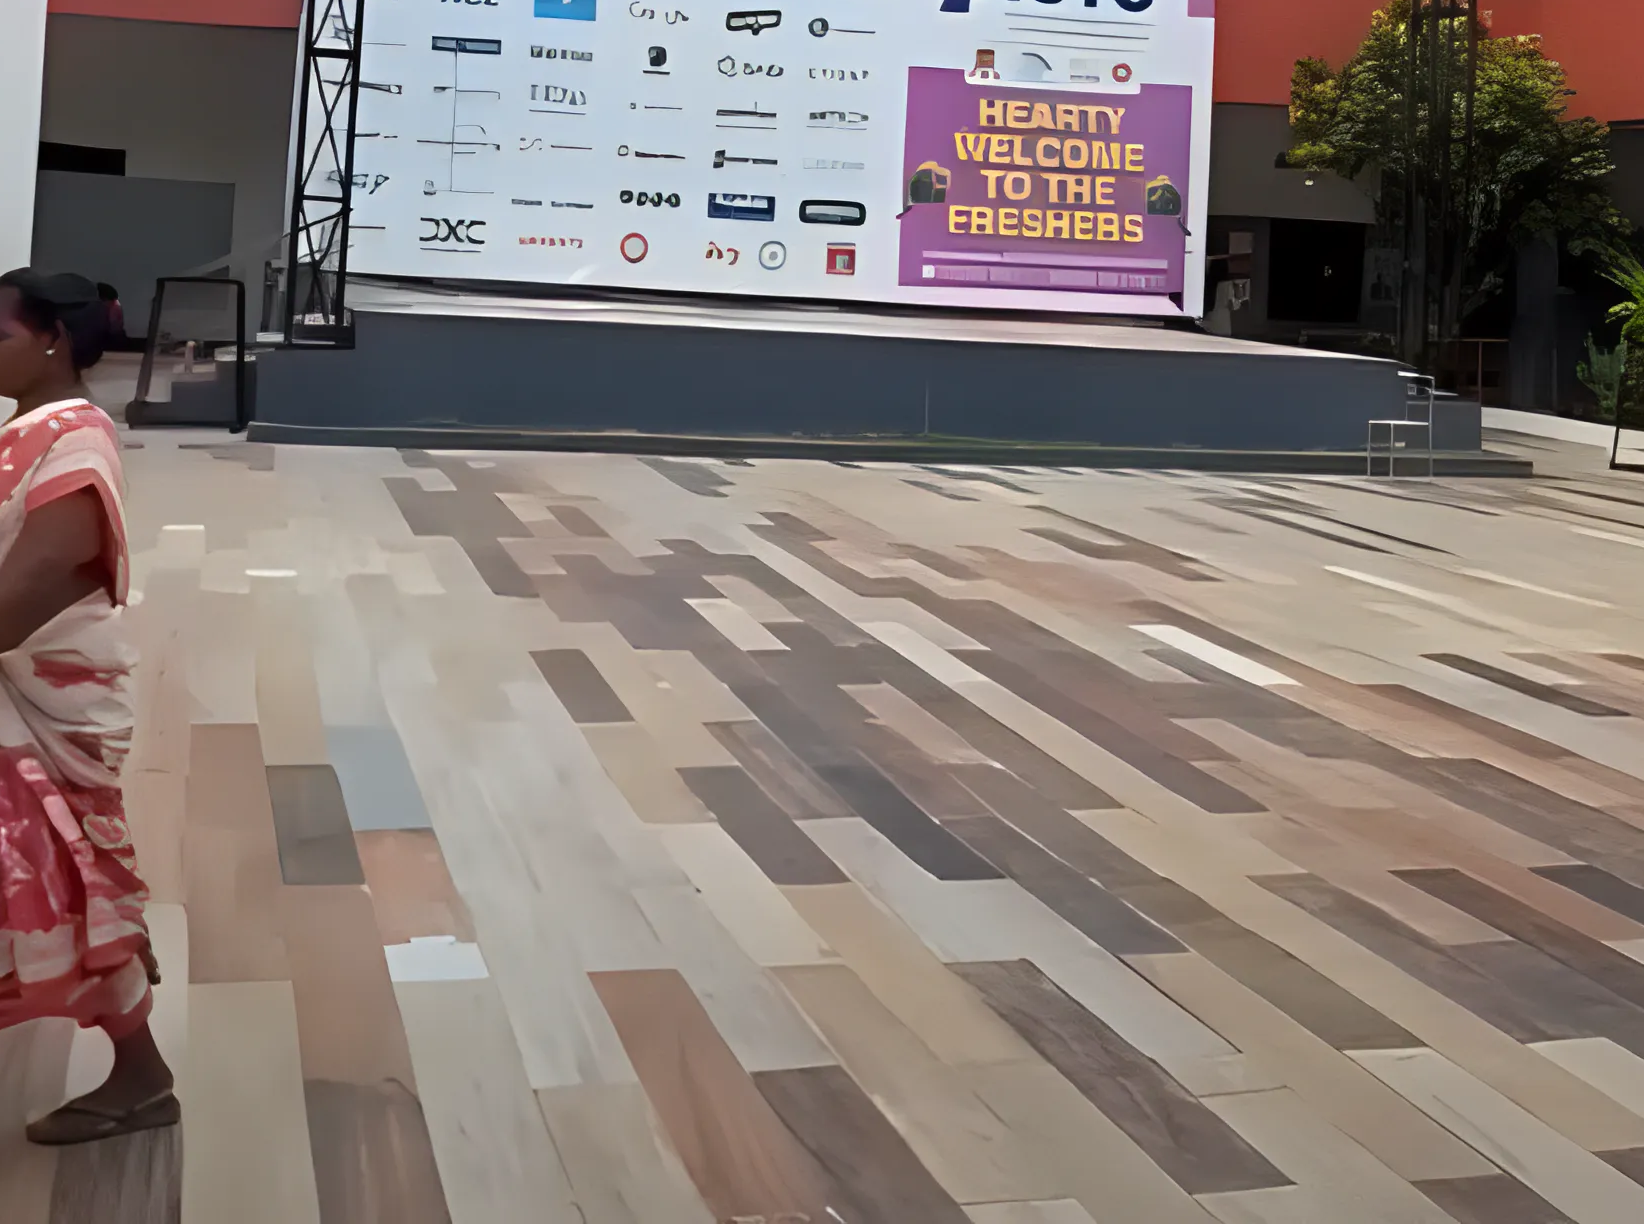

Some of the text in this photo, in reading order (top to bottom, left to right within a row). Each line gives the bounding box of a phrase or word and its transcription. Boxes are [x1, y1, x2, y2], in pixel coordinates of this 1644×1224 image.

[979, 97, 1126, 135] HEARTY
[980, 169, 1117, 206] TO THE
